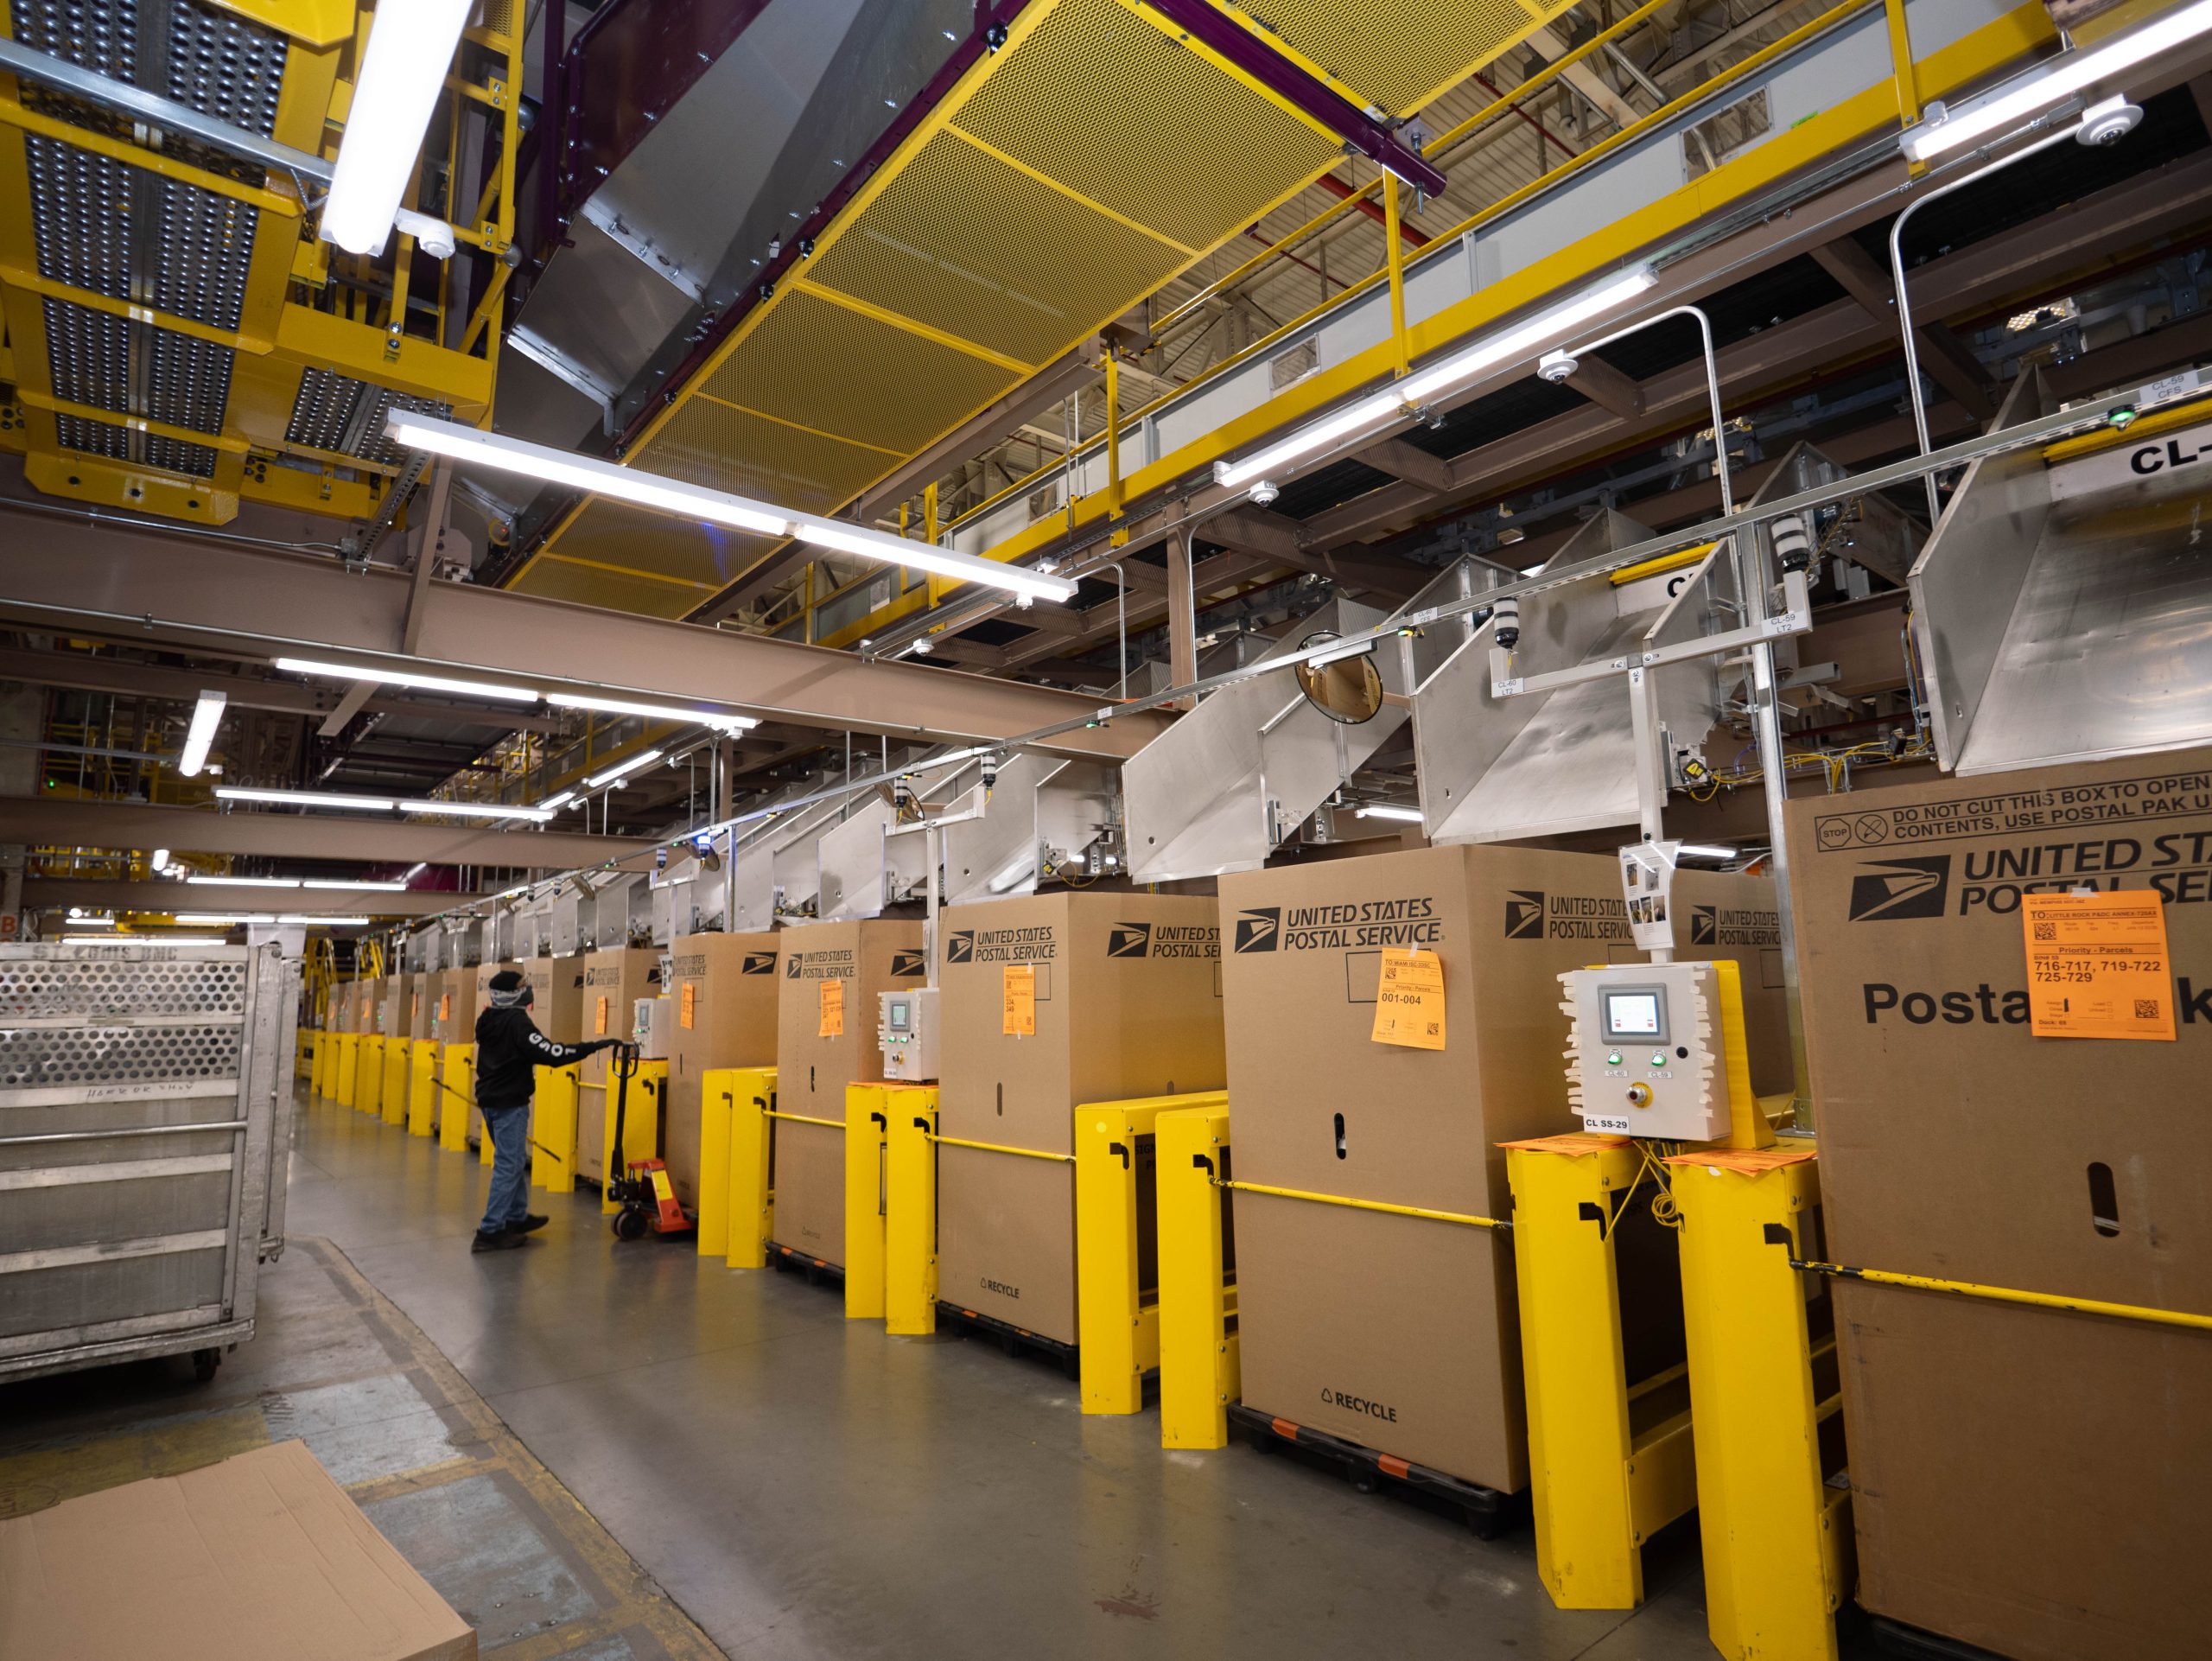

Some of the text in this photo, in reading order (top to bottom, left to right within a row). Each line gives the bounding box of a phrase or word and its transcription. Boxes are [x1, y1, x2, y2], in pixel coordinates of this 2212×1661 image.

[2152, 375, 2184, 391] CL-59
[2158, 385, 2182, 398] CFS
[1418, 608, 1433, 617] CL-60
[1771, 614, 1796, 626] CL-59
[1777, 624, 1792, 633] LT2
[1497, 679, 1516, 688] CL-60
[1893, 775, 2210, 823] DO NOT CUT THIS BOX TO OPEN
[1894, 818, 1999, 838] CONTENTS,
[2005, 811, 2045, 828] USE
[2051, 802, 2135, 823] POSTAL
[2142, 796, 2188, 813] PAK
[1823, 827, 1847, 838] STOP
[1964, 830, 2212, 881] UNITED ST
[2149, 870, 2212, 904] SE
[1287, 897, 1433, 927] UNITED STATES
[1550, 896, 1597, 915] UNITED
[1719, 910, 1752, 926] UNITED
[977, 926, 1052, 945] UNITED STATES
[1156, 926, 1220, 940] UNITED ST
[1284, 923, 1441, 951] POSTAL SERVICE
[1549, 920, 1595, 939] POSTAL
[1597, 922, 1634, 939] SERVIC
[1719, 930, 1781, 945] POSTAL SERVIC
[804, 950, 853, 963] UNITED STATES
[976, 945, 1056, 962] POSTAL SERVICE
[1153, 944, 1221, 958] POSTAL SE
[803, 966, 855, 978] POSTAL SERVICE
[2034, 961, 2161, 973] 716-717, 719-722
[2036, 972, 2093, 982] 725-729
[1382, 992, 1421, 1005] 001-004
[1863, 983, 2031, 1024] Posta
[1601, 1120, 1628, 1129] SS-29
[988, 1279, 1020, 1299] RECYCLE
[1335, 1391, 1397, 1423] RECYCLE
